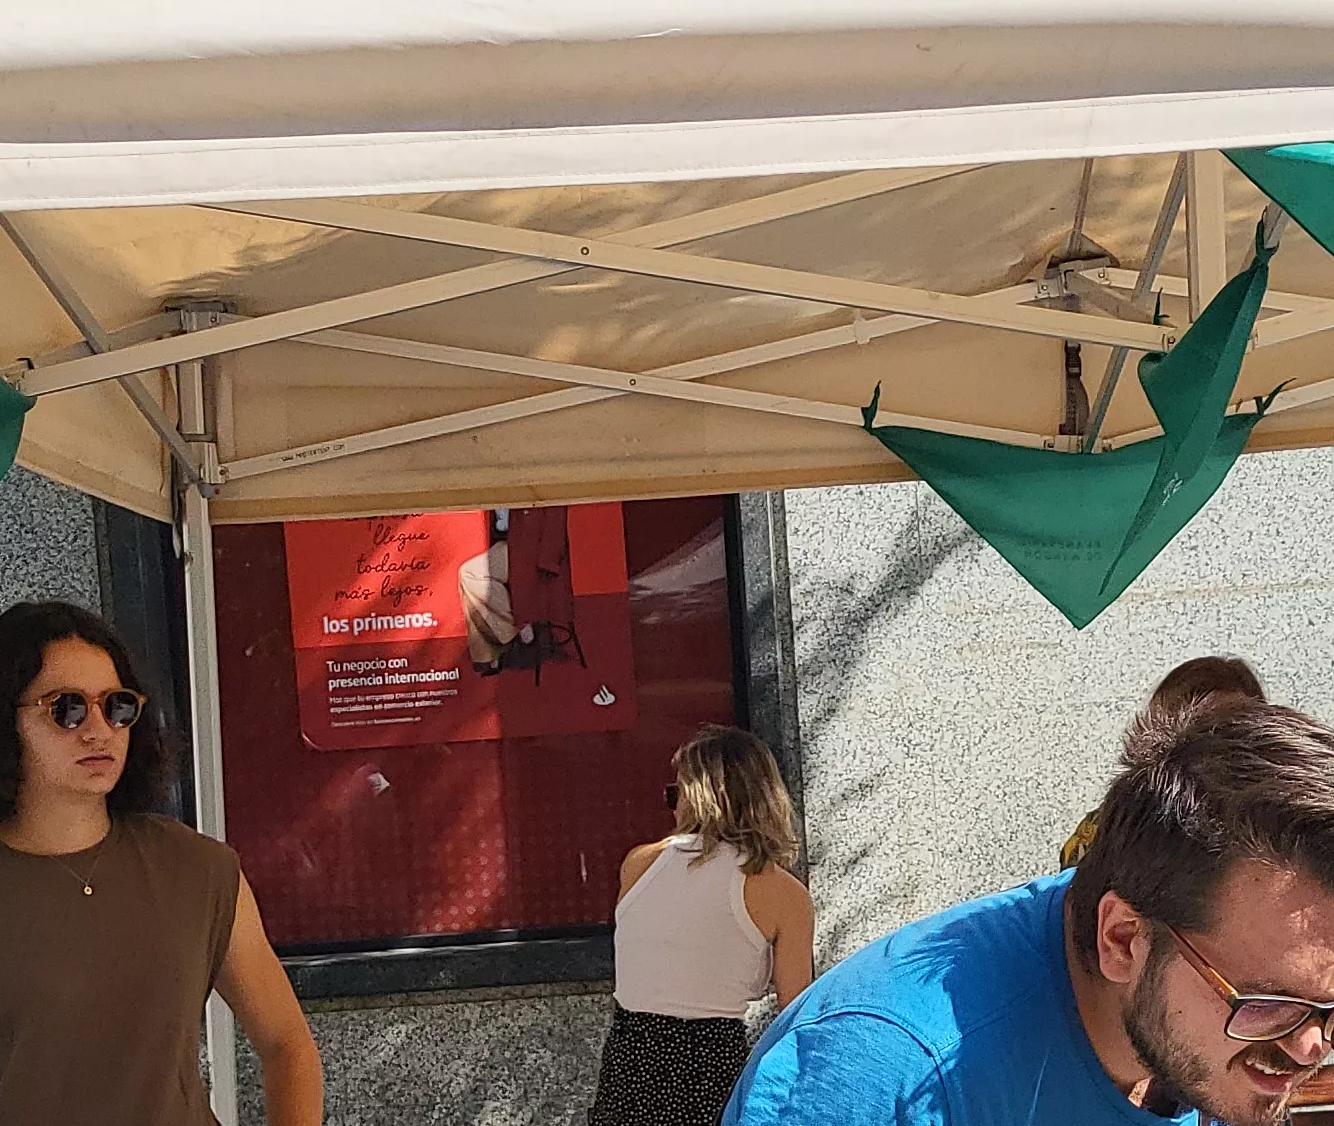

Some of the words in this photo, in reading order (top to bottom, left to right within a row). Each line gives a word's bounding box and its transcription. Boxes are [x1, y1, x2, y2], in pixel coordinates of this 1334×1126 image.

[372, 523, 431, 552] llegue
[323, 615, 350, 634] los
[353, 612, 439, 636] primeros.
[326, 660, 341, 673] Tu
[343, 657, 387, 675] negocio
[388, 658, 408, 670] con
[328, 673, 384, 692] presencia
[384, 668, 460, 685] internacional
